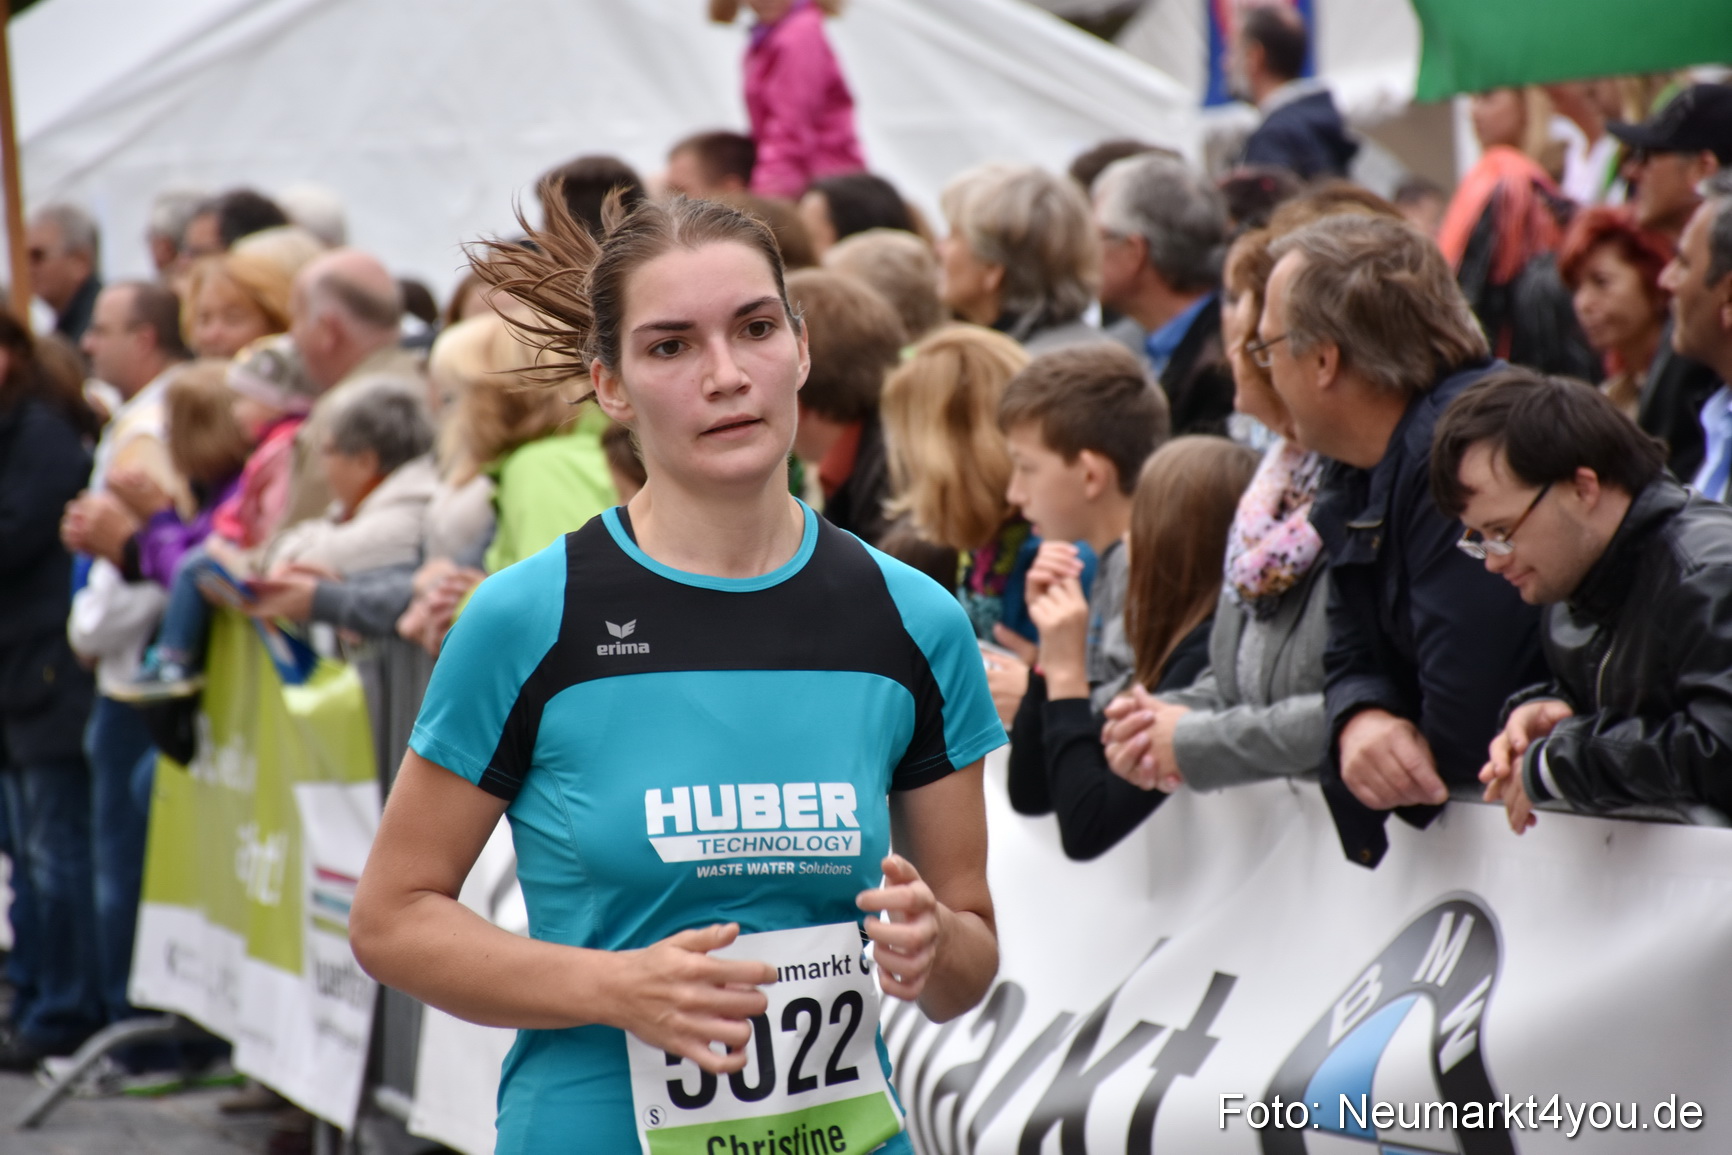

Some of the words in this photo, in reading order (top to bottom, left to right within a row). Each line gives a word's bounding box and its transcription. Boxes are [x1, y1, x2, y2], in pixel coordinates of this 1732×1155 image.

[596, 641, 650, 656] erima
[644, 782, 861, 836] HUBER
[696, 835, 853, 855] TECHNOLOGY
[696, 863, 743, 879] WASTE
[747, 862, 795, 875] WATER
[798, 861, 853, 875] Solutions
[1327, 910, 1493, 1076] BMW
[664, 990, 865, 1111] 5022
[649, 1108, 660, 1126] S
